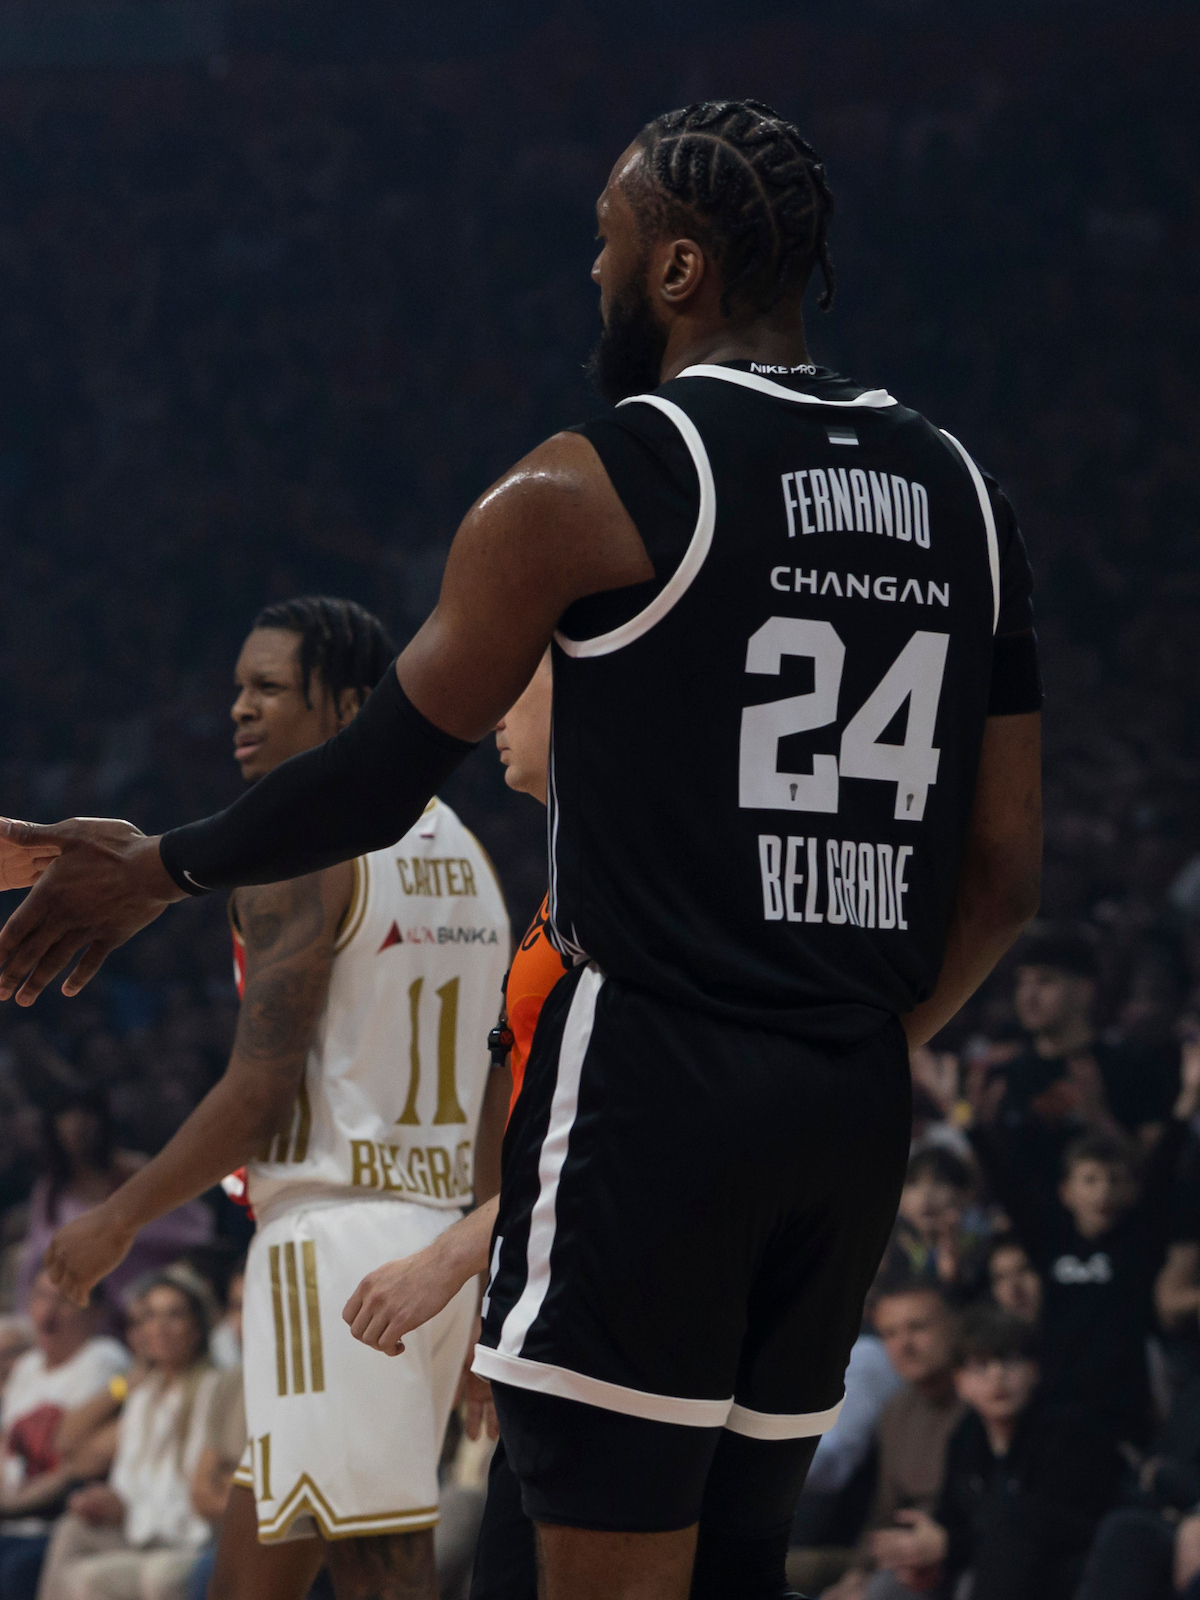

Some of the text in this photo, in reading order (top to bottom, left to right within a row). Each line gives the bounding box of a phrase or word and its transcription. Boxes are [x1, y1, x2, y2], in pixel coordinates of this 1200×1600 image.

[750, 362, 817, 376] NIKE PRO
[781, 467, 931, 550] FERNANDO
[770, 566, 950, 608] CHANGAN
[738, 615, 951, 822] 24
[758, 834, 914, 931] BELGRADE
[394, 975, 468, 1126] 11
